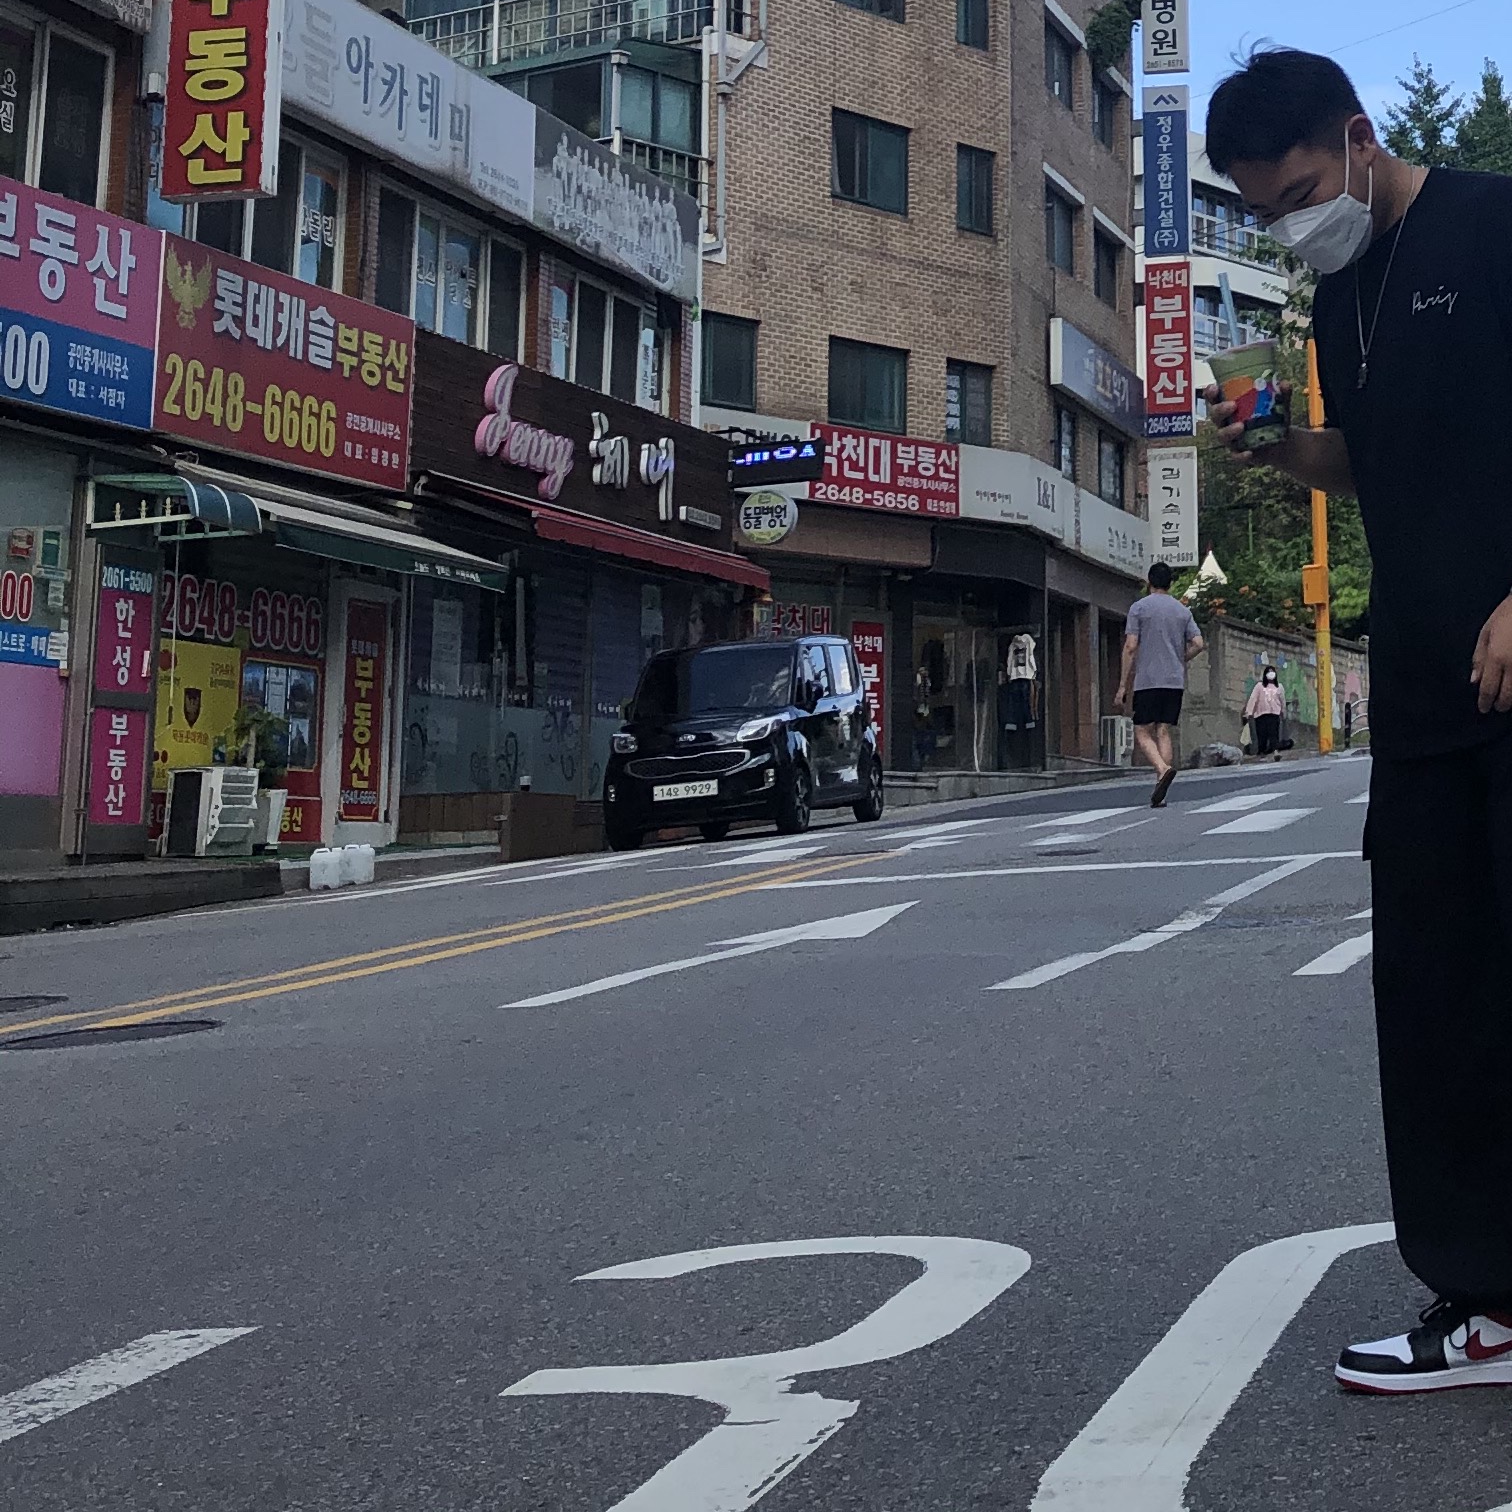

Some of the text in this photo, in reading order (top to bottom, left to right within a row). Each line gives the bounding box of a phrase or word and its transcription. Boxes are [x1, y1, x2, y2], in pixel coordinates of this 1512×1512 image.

[1154, 116, 1179, 248] 정우종합건설(주)
[1148, 268, 1188, 289] 낙천대
[0, 324, 50, 395] 00
[1150, 295, 1188, 405] 부동산
[162, 353, 337, 458] 2648-6666
[814, 482, 919, 511] 2648-5656
[896, 443, 958, 479] 부동산
[1036, 477, 1056, 513] I&I
[743, 504, 788, 529] 동물병원
[102, 565, 153, 594] 2061-5500
[161, 570, 322, 655] 2648-6666
[112, 597, 136, 686] 한성
[350, 657, 374, 788] 부동산
[104, 713, 129, 816] 부동산
[684, 783, 711, 796] 9929
